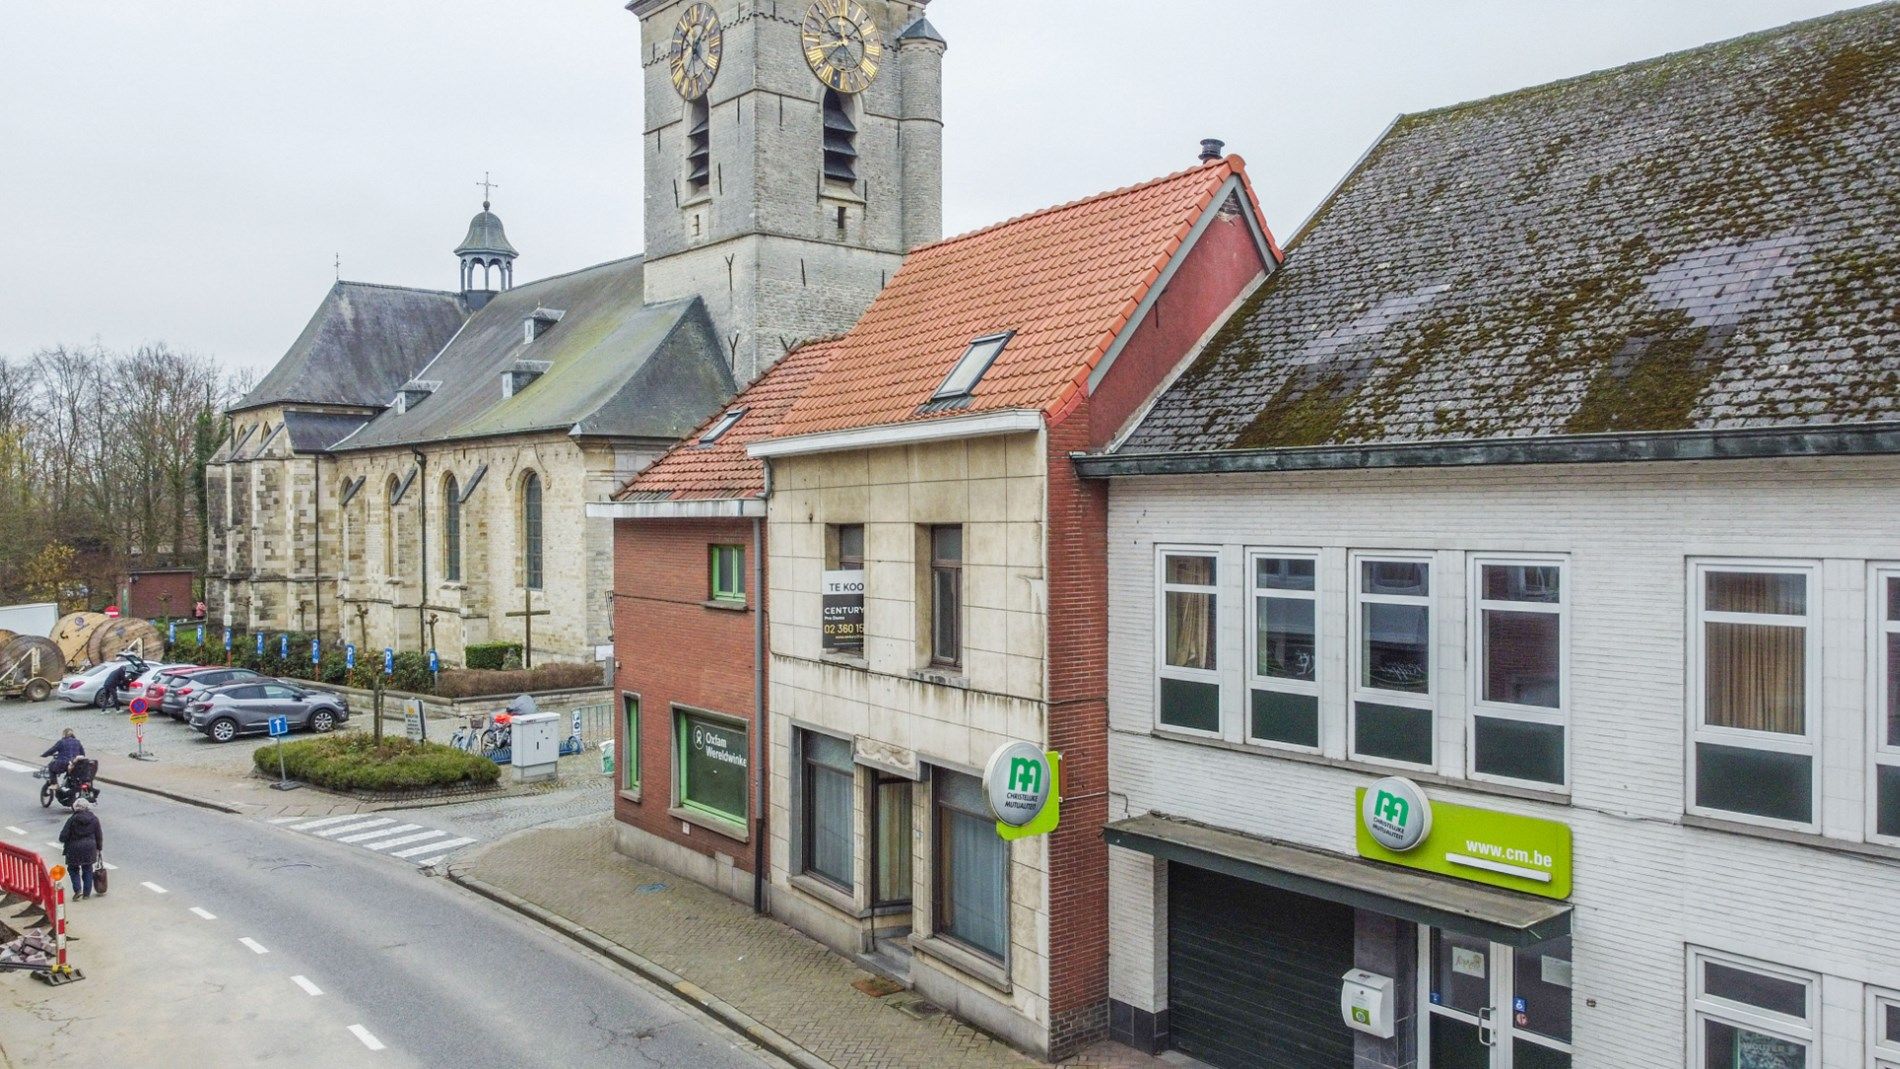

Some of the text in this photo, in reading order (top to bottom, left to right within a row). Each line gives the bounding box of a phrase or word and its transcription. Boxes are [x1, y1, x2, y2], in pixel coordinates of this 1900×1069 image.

[829, 583, 841, 591] TE
[824, 606, 864, 615] CENTURY
[824, 624, 836, 634] 02
[705, 732, 727, 748] Oxfam
[1466, 840, 1552, 867] www.cm.be
